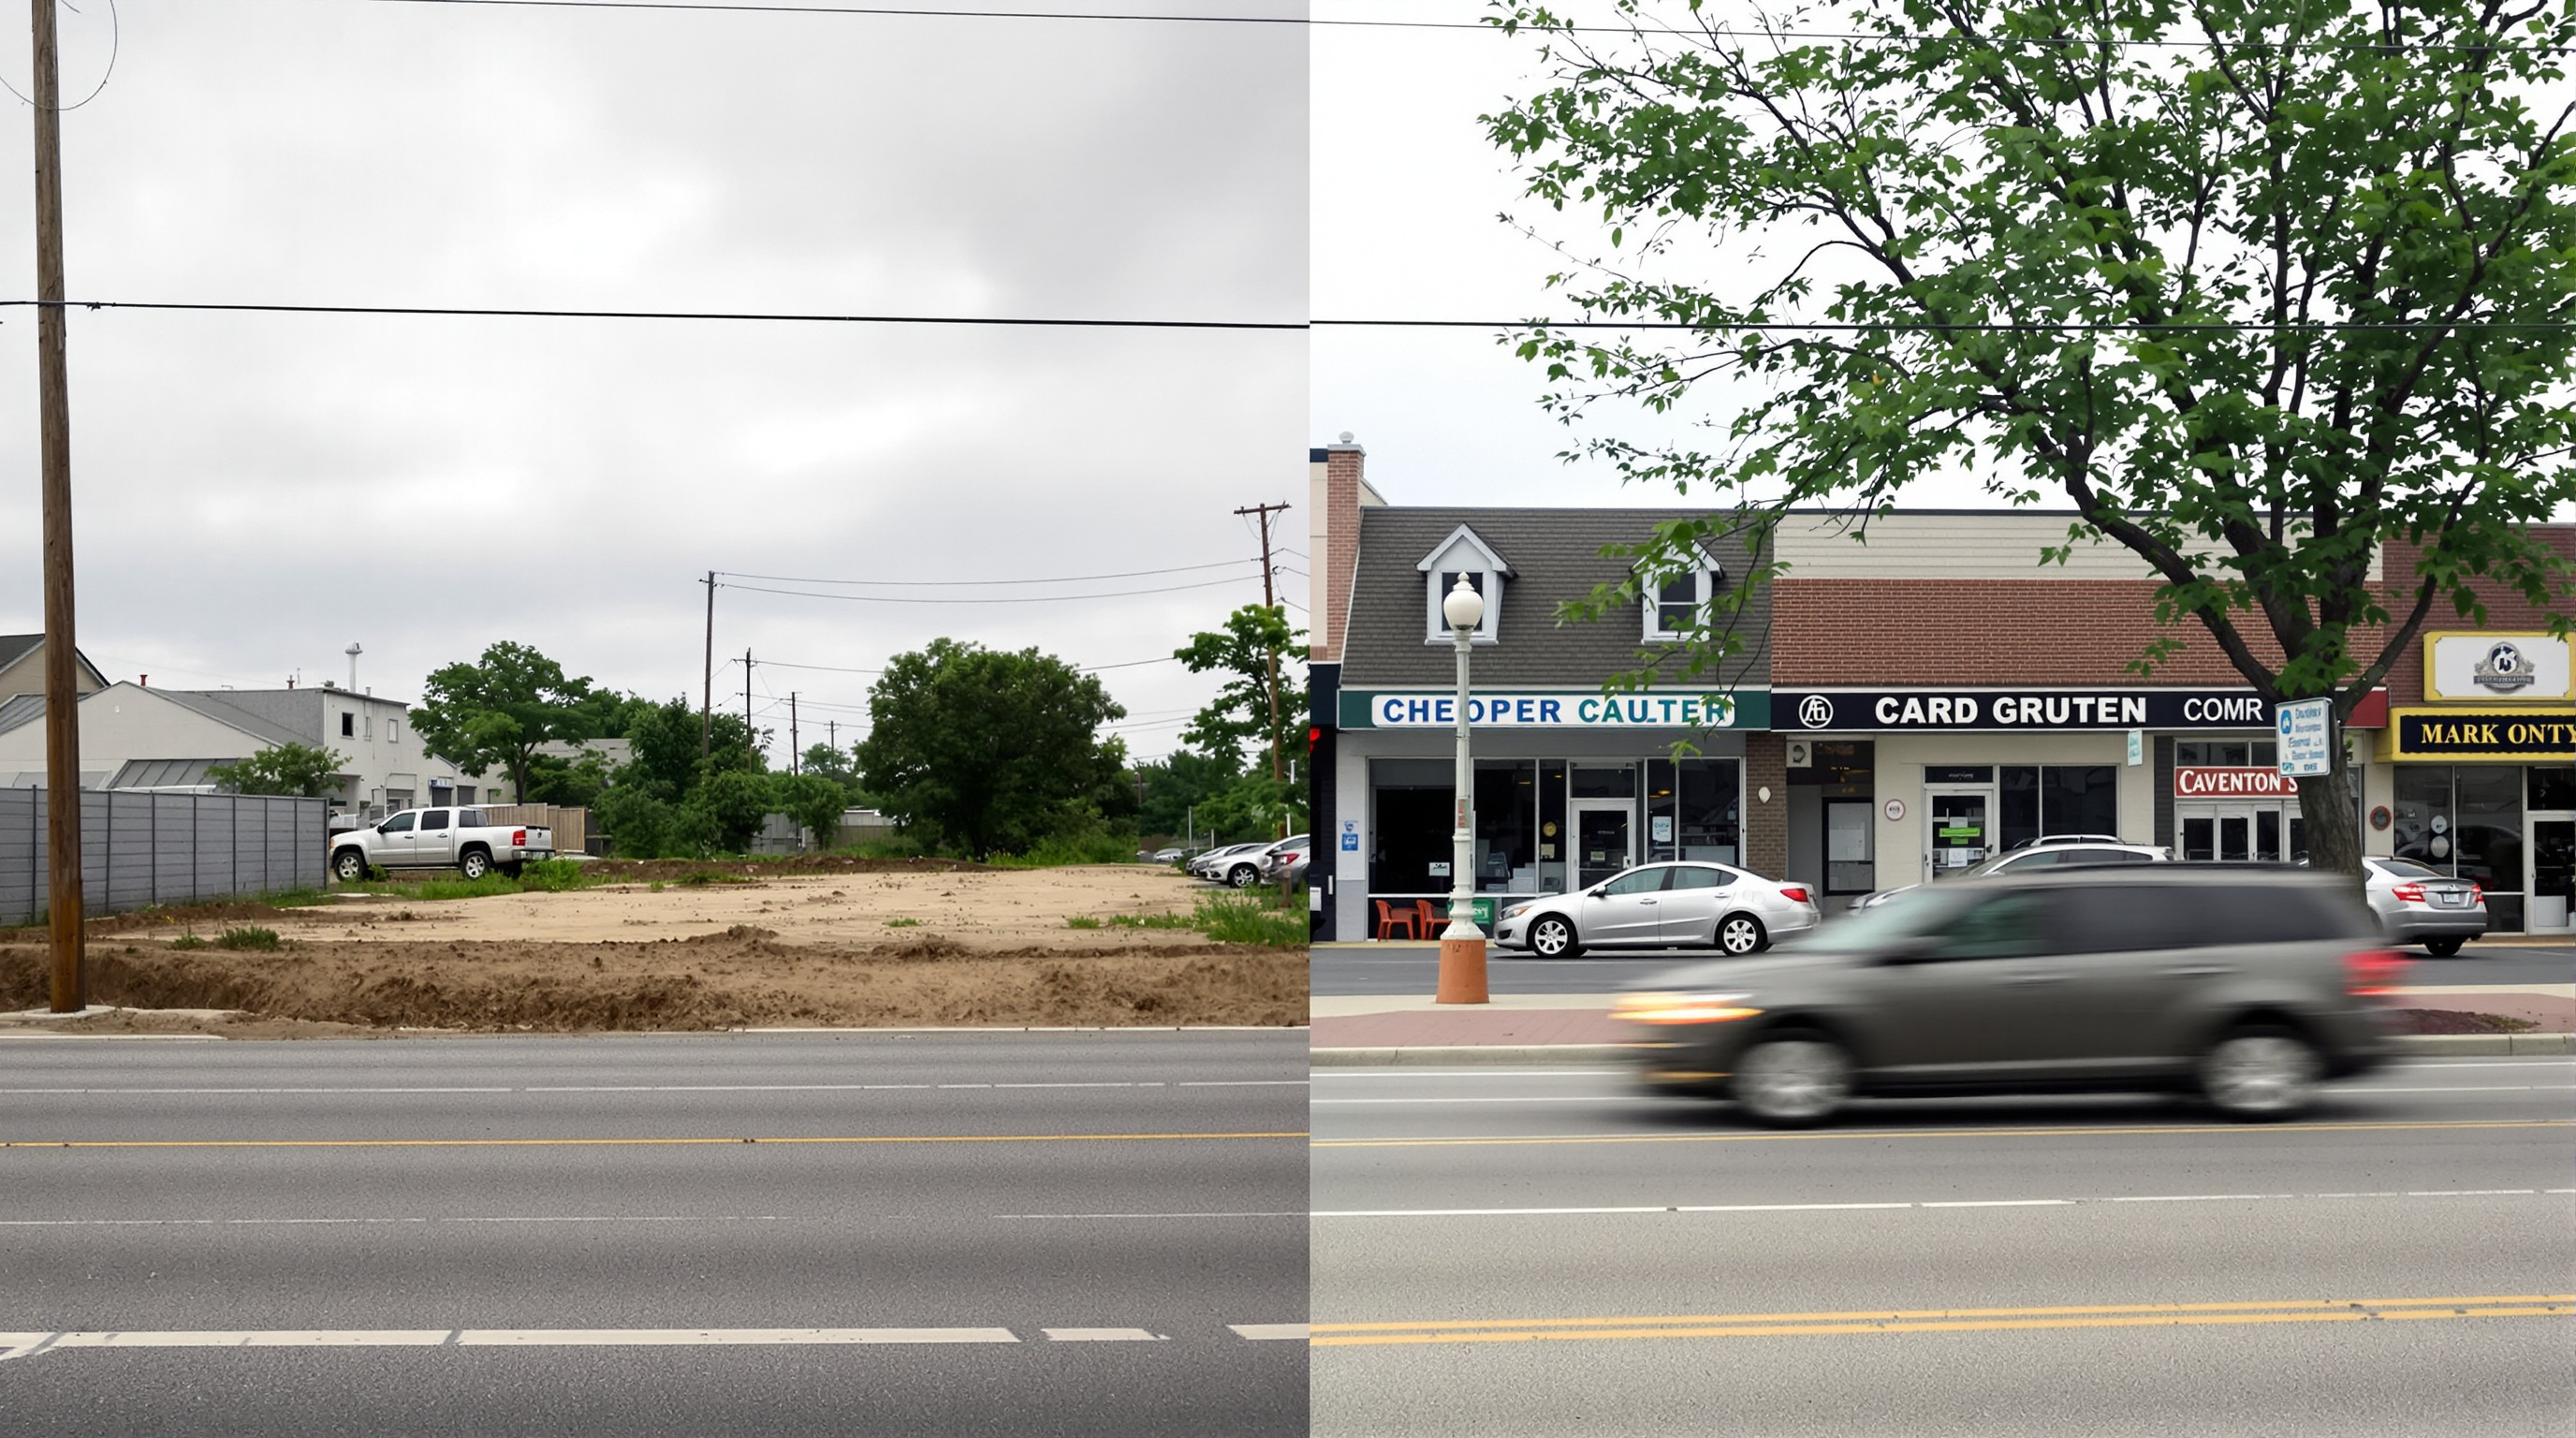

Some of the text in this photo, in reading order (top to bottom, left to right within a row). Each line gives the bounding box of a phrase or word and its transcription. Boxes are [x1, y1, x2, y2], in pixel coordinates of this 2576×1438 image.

[1875, 697, 2146, 724] CARD GRUTEN
[2183, 697, 2263, 723] COMR
[2421, 724, 2499, 744] MARK
